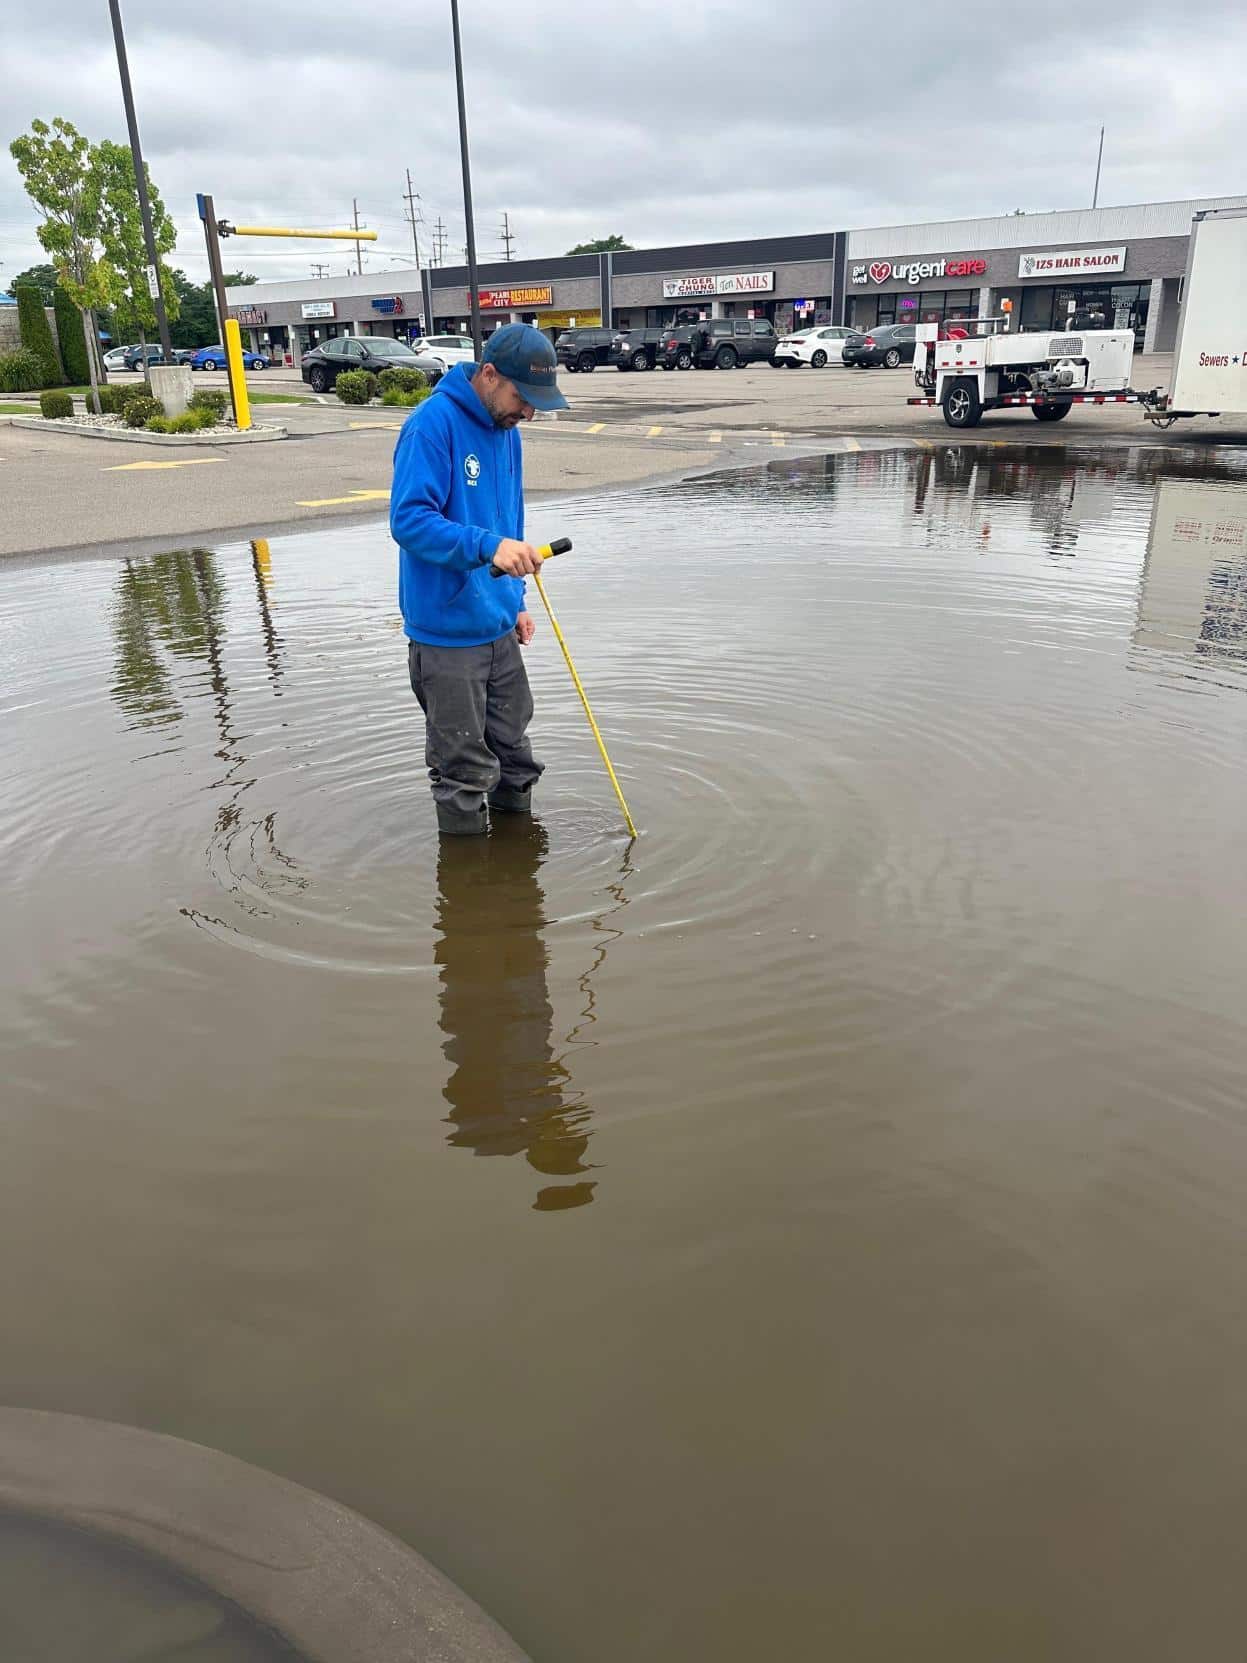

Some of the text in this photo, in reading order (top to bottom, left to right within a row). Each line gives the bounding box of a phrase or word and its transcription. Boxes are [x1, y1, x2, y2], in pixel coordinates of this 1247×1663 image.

[1055, 257, 1081, 269] HAIR
[1083, 254, 1119, 266] SALON
[681, 277, 712, 285] TIGER
[736, 275, 768, 289] NAILS
[511, 287, 550, 302] RESTAURANT
[493, 298, 509, 307] CITY
[1199, 352, 1229, 367] Sewers
